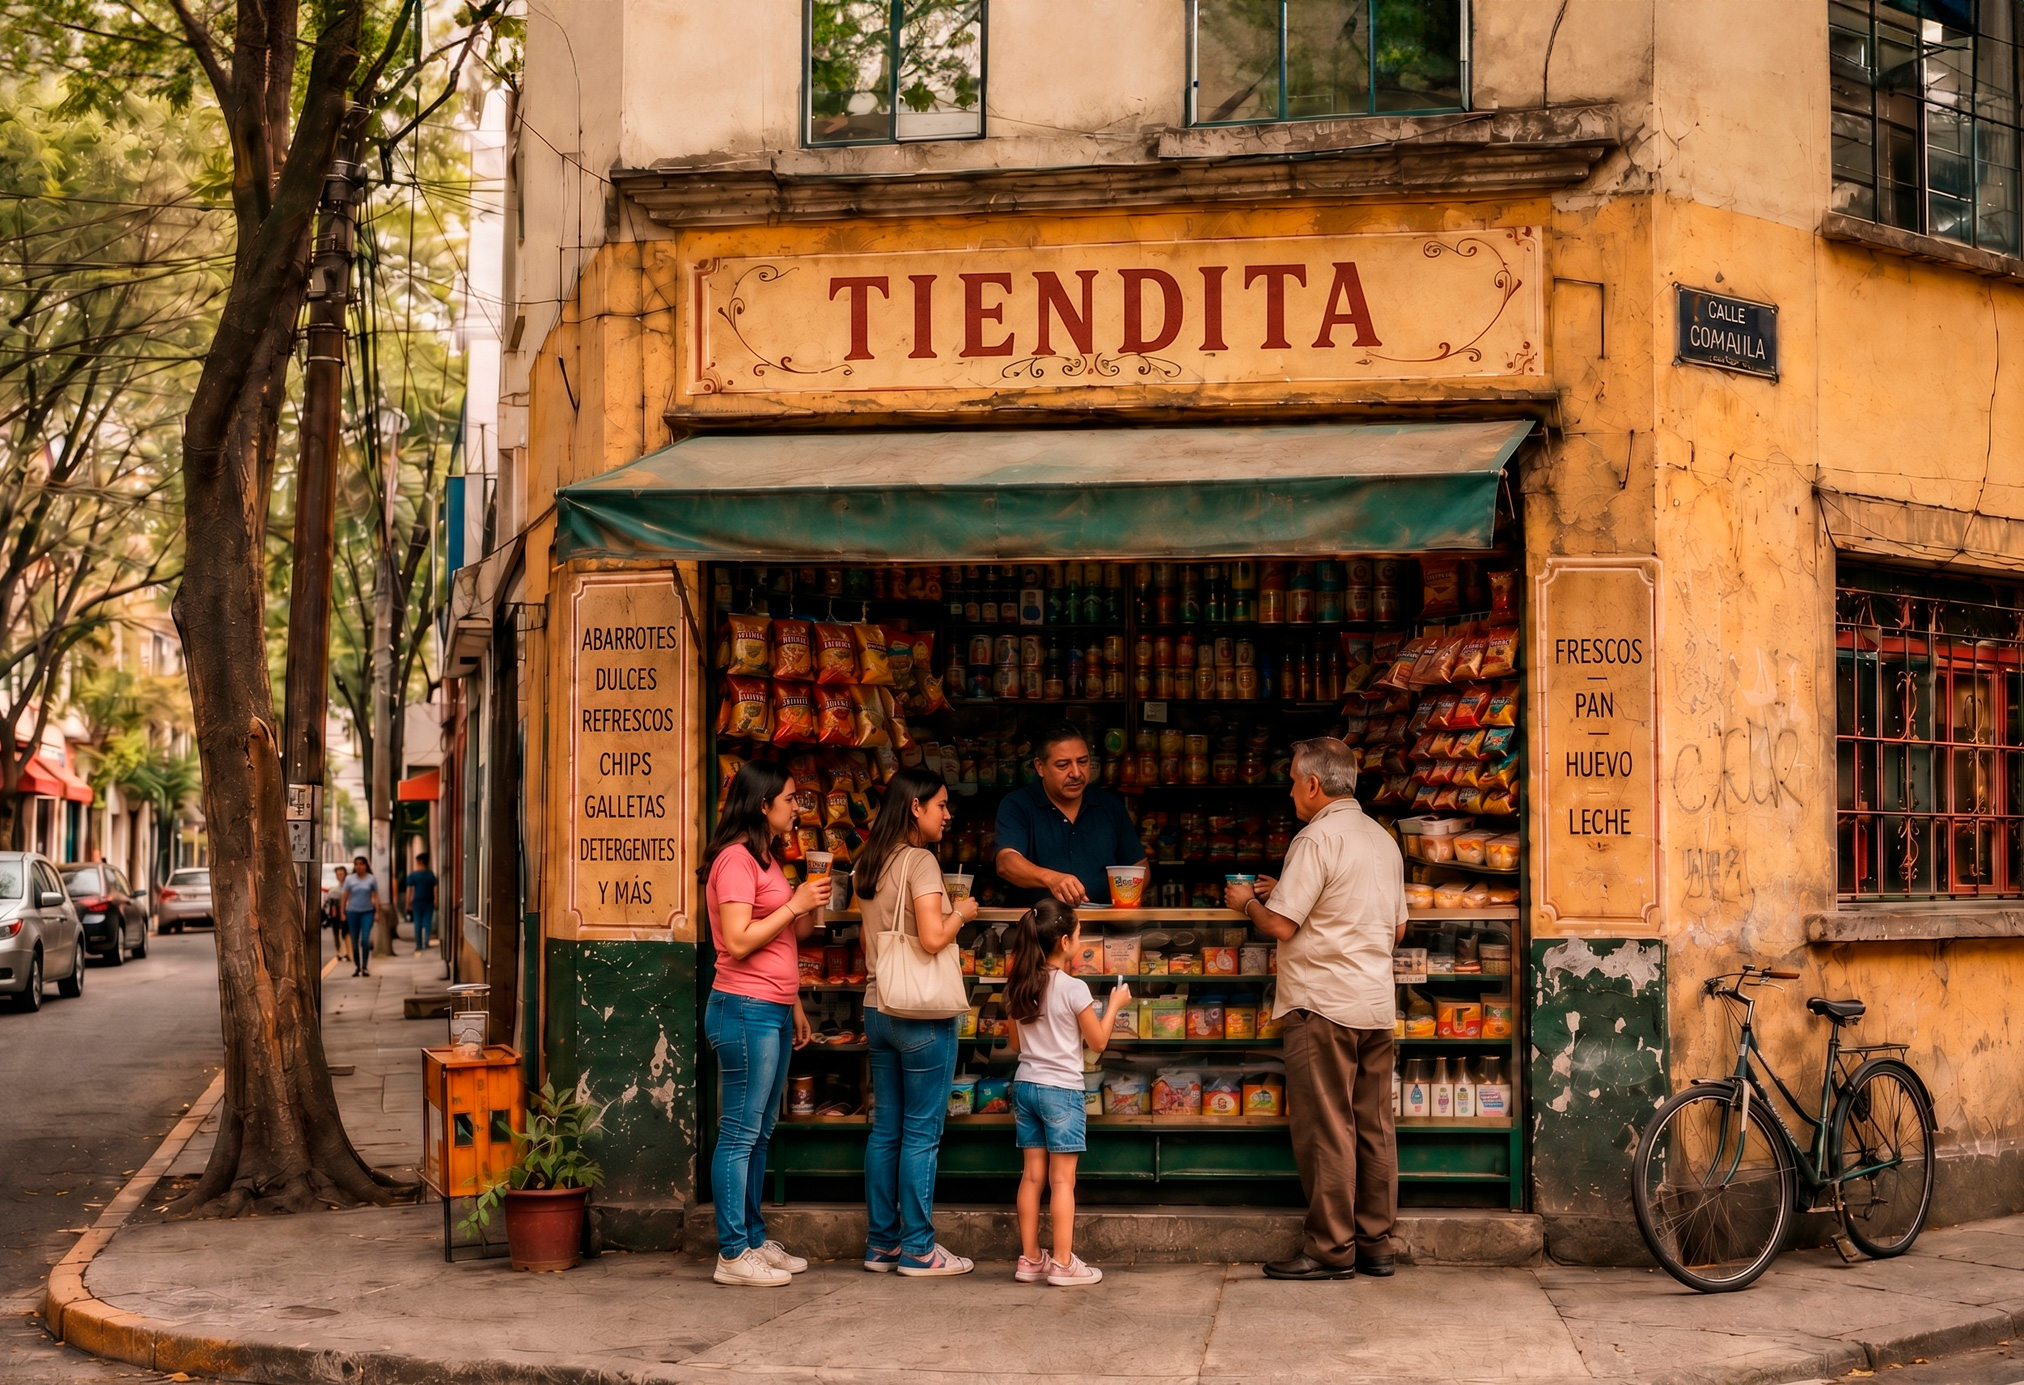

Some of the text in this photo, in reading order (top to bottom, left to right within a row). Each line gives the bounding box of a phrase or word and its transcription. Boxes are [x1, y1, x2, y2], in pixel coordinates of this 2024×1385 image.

[828, 261, 1383, 362] TIENDITA
[1708, 300, 1746, 324] CALLE
[581, 625, 677, 652] ABARROTES
[1555, 638, 1643, 665] FRESCOS
[596, 667, 657, 691] DULCES
[1575, 692, 1614, 718] PAN
[582, 707, 674, 733] REFRESCOS
[599, 751, 652, 776] CHIPS
[1566, 750, 1633, 778] HUEVO
[584, 794, 666, 819] GALLETAS
[1569, 808, 1632, 835] LECHE
[580, 837, 675, 862] DETERGENTES
[598, 874, 652, 905] Y MÁS
